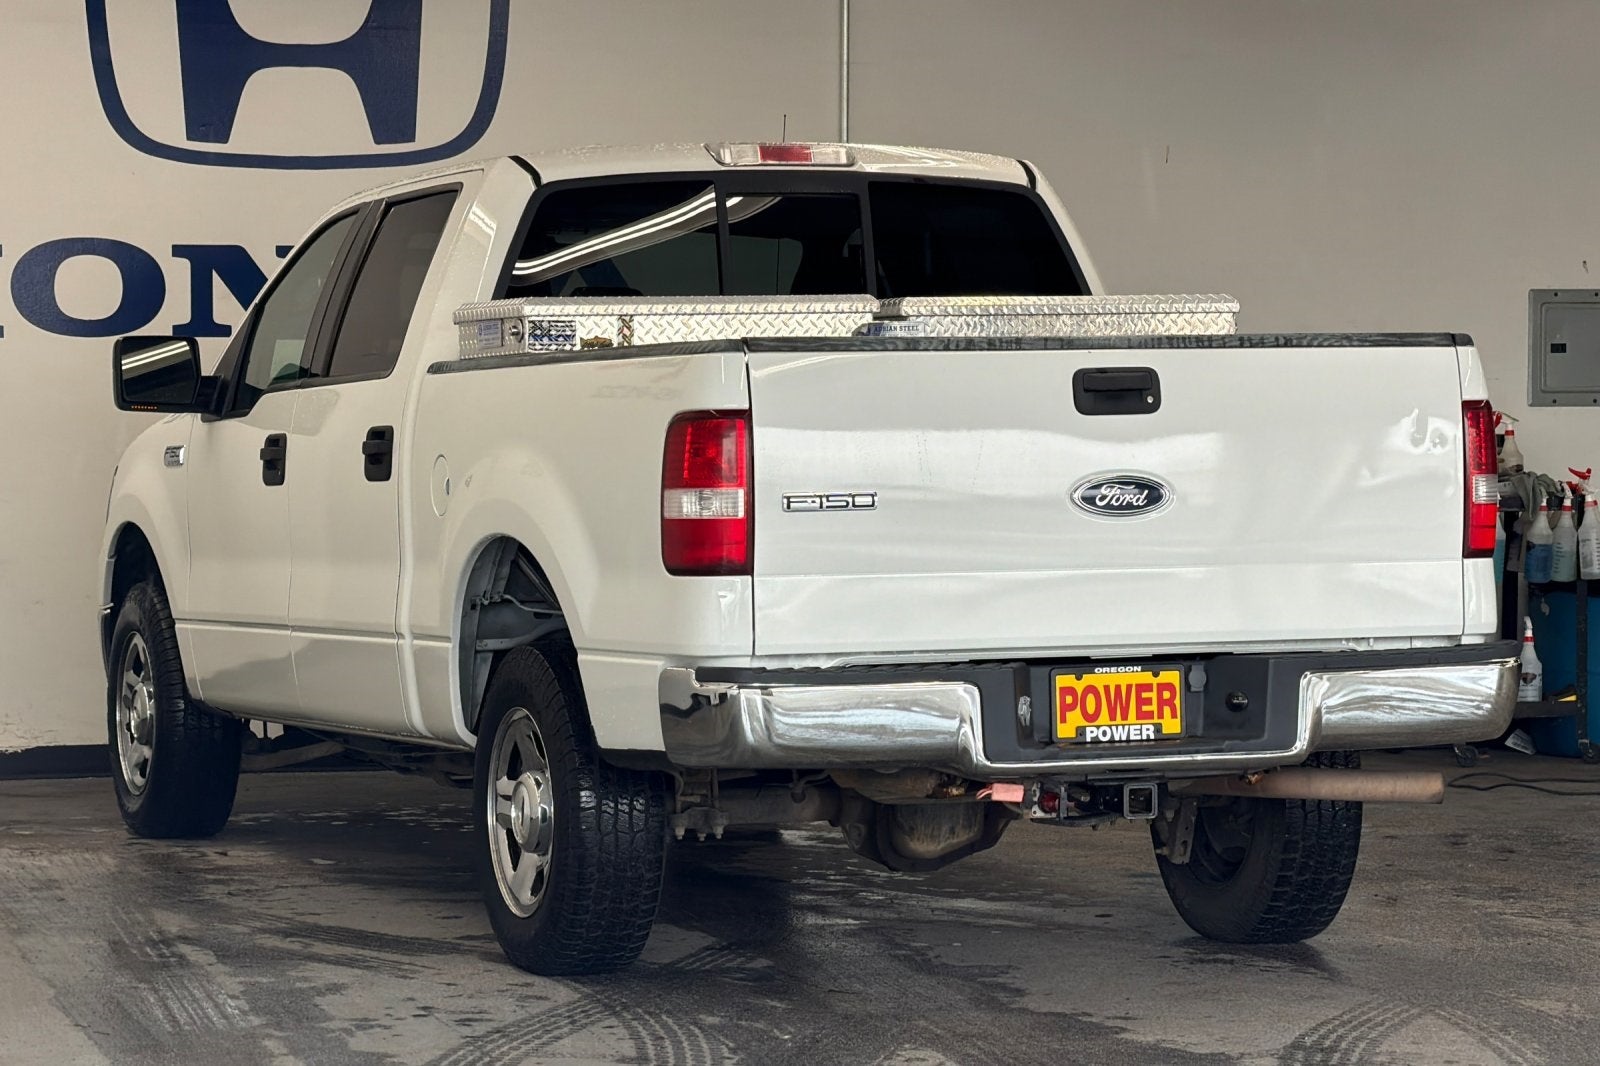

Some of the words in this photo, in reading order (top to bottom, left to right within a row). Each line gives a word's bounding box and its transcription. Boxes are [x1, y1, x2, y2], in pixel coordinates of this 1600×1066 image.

[0, 236, 295, 337] ON
[783, 492, 877, 510] F-150
[1095, 483, 1148, 506] Ford
[1059, 683, 1177, 723] POWER
[1086, 725, 1154, 742] POWER
